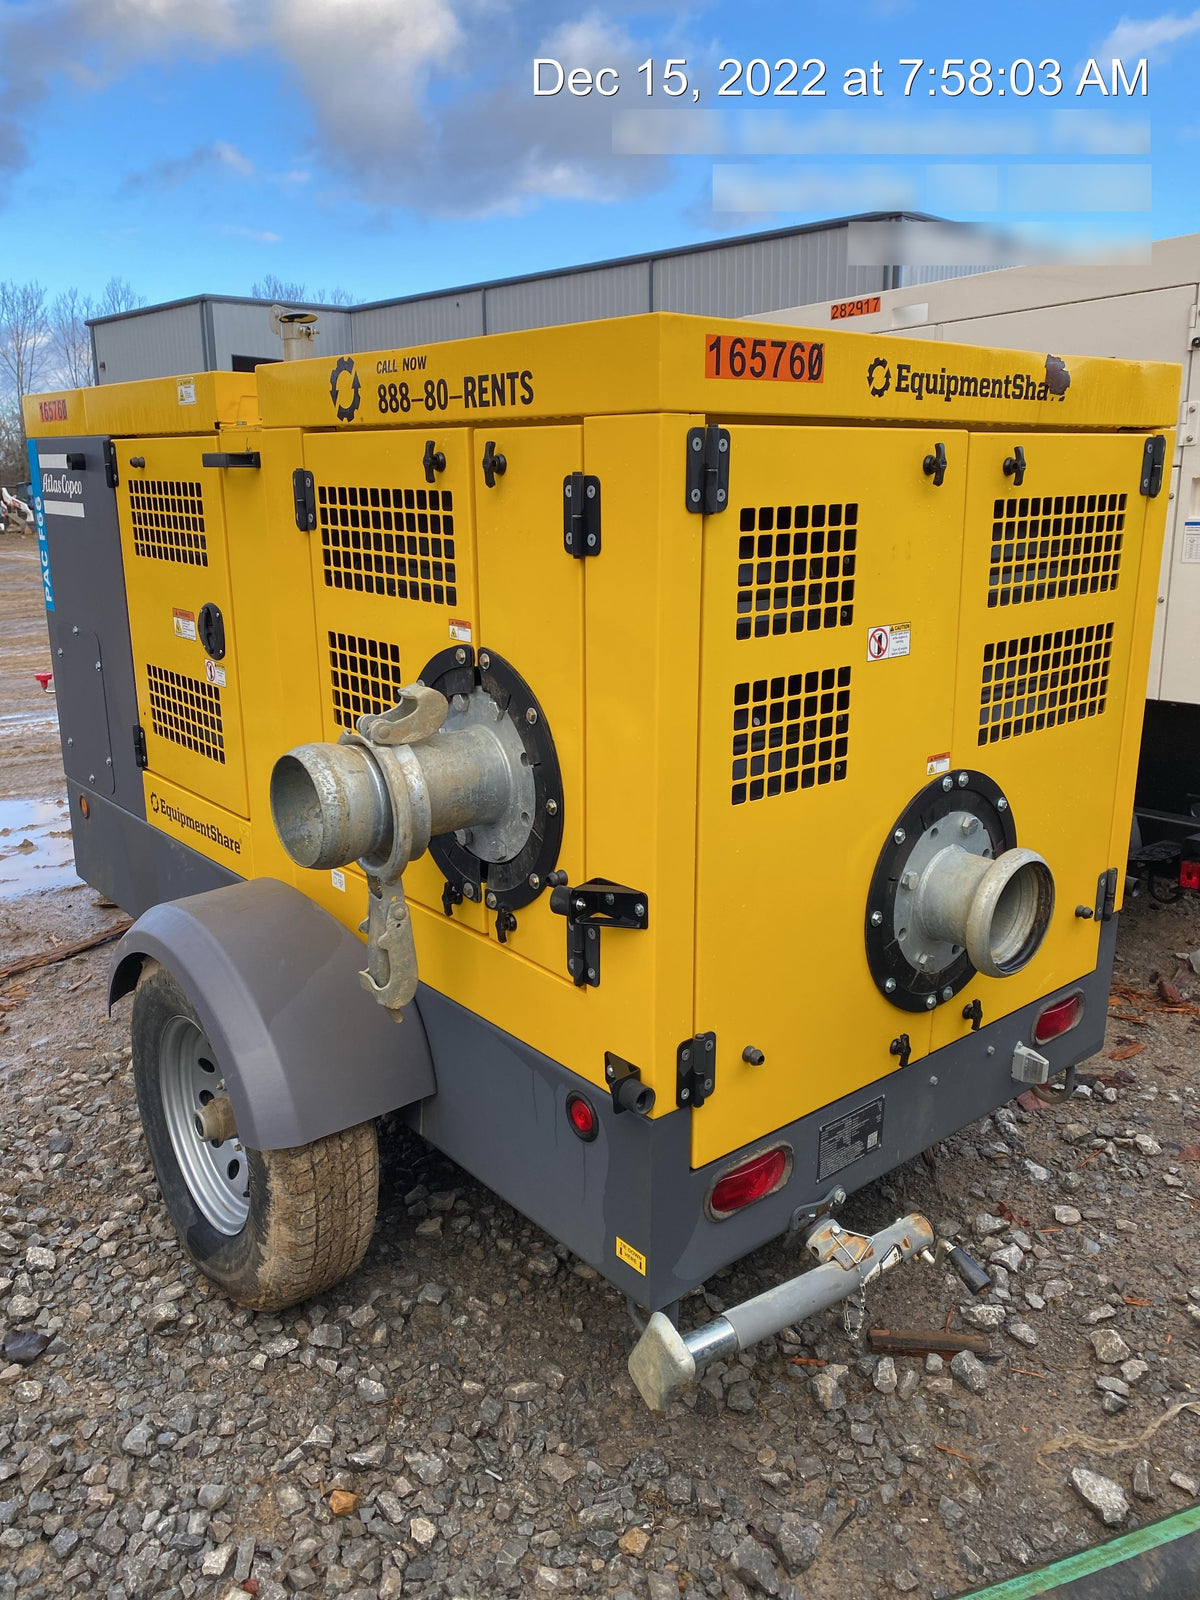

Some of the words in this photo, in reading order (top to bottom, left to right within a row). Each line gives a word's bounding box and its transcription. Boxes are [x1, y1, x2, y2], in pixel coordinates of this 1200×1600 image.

[831, 297, 881, 320] 282917
[376, 359, 398, 374] CALL
[402, 355, 427, 372] NOW
[708, 335, 824, 381] 165760
[895, 363, 1066, 402] EquipmentSha
[39, 399, 68, 421] 165760
[41, 551, 52, 602] PAC
[160, 798, 241, 854] EquipmentShare
